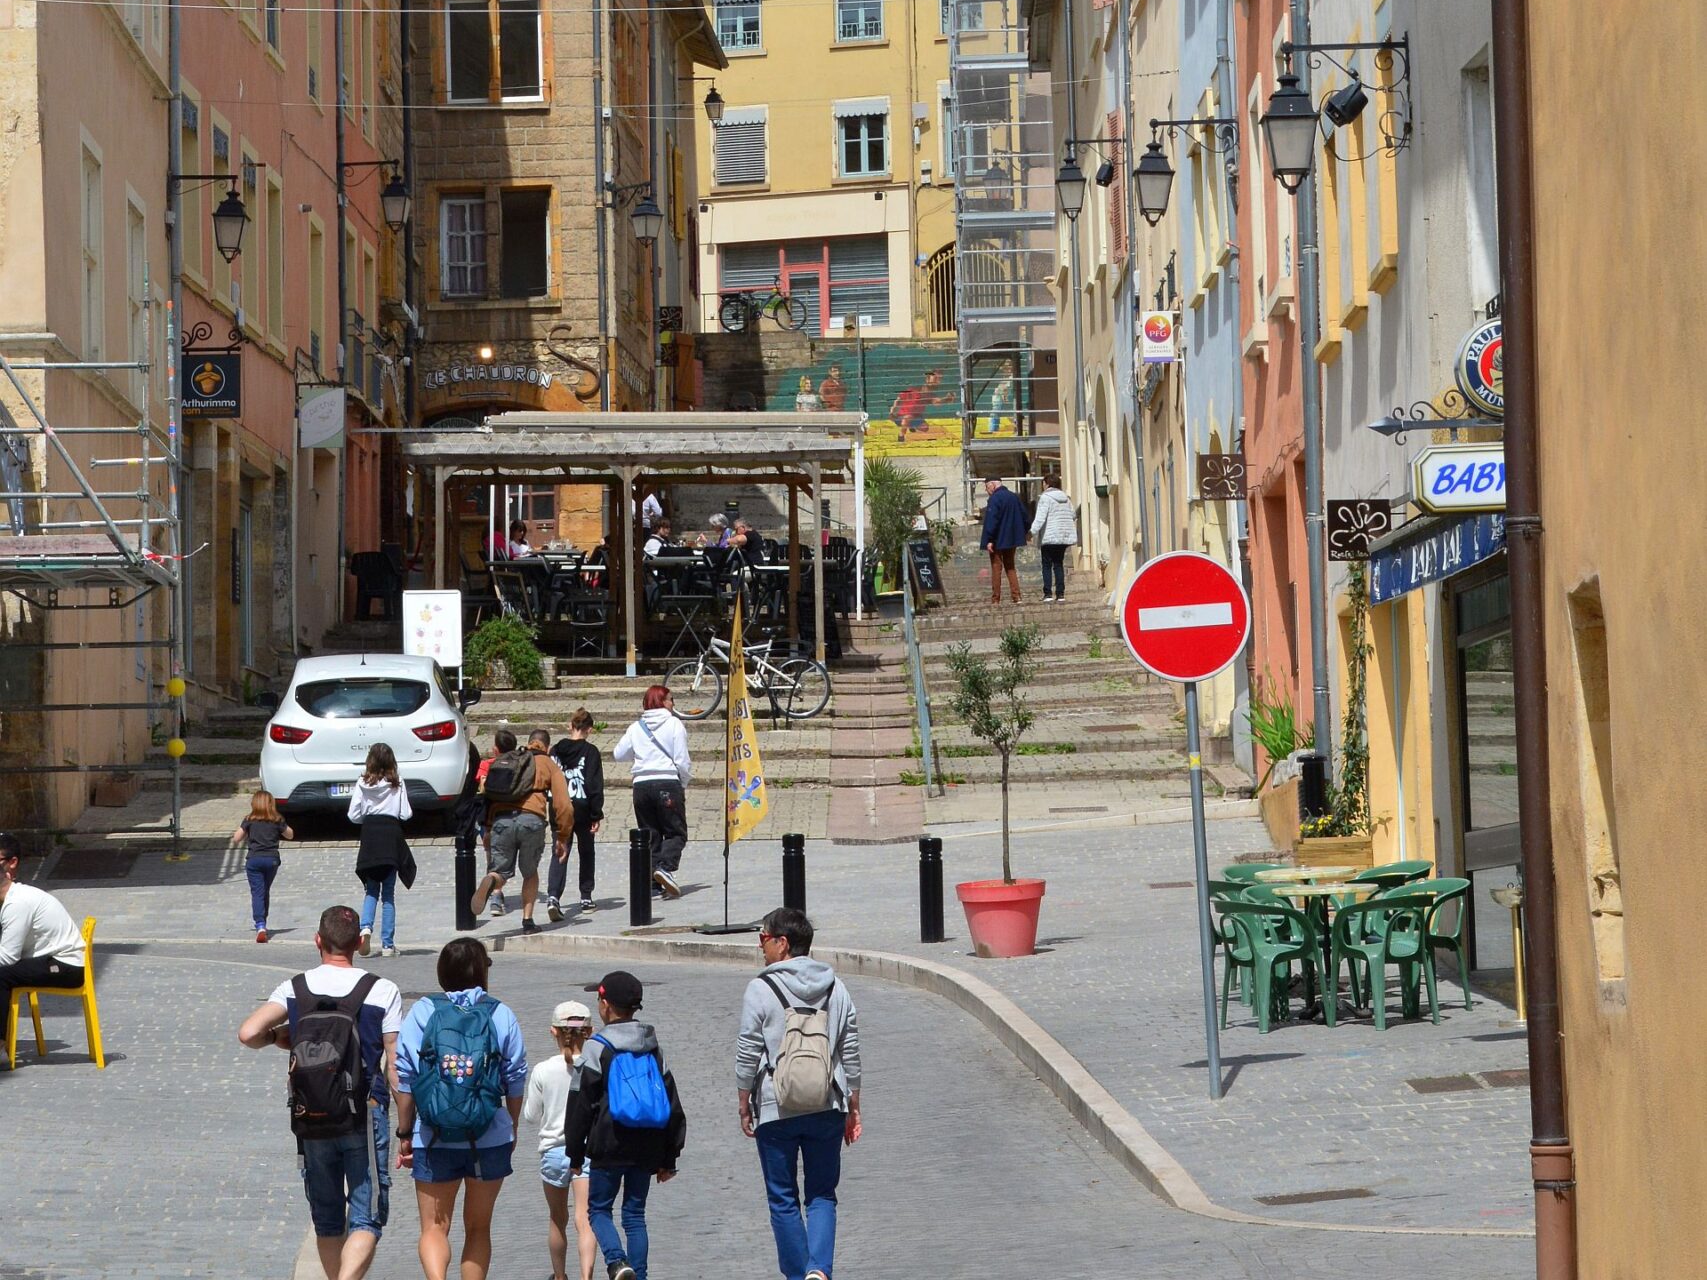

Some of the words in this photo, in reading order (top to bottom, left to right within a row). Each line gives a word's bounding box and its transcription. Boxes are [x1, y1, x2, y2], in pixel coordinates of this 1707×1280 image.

[1149, 329, 1167, 338] PFG
[425, 369, 447, 389] LE
[450, 364, 553, 389] CHAUDRON
[182, 399, 237, 408] Arthurimmo
[1432, 462, 1506, 495] BABY
